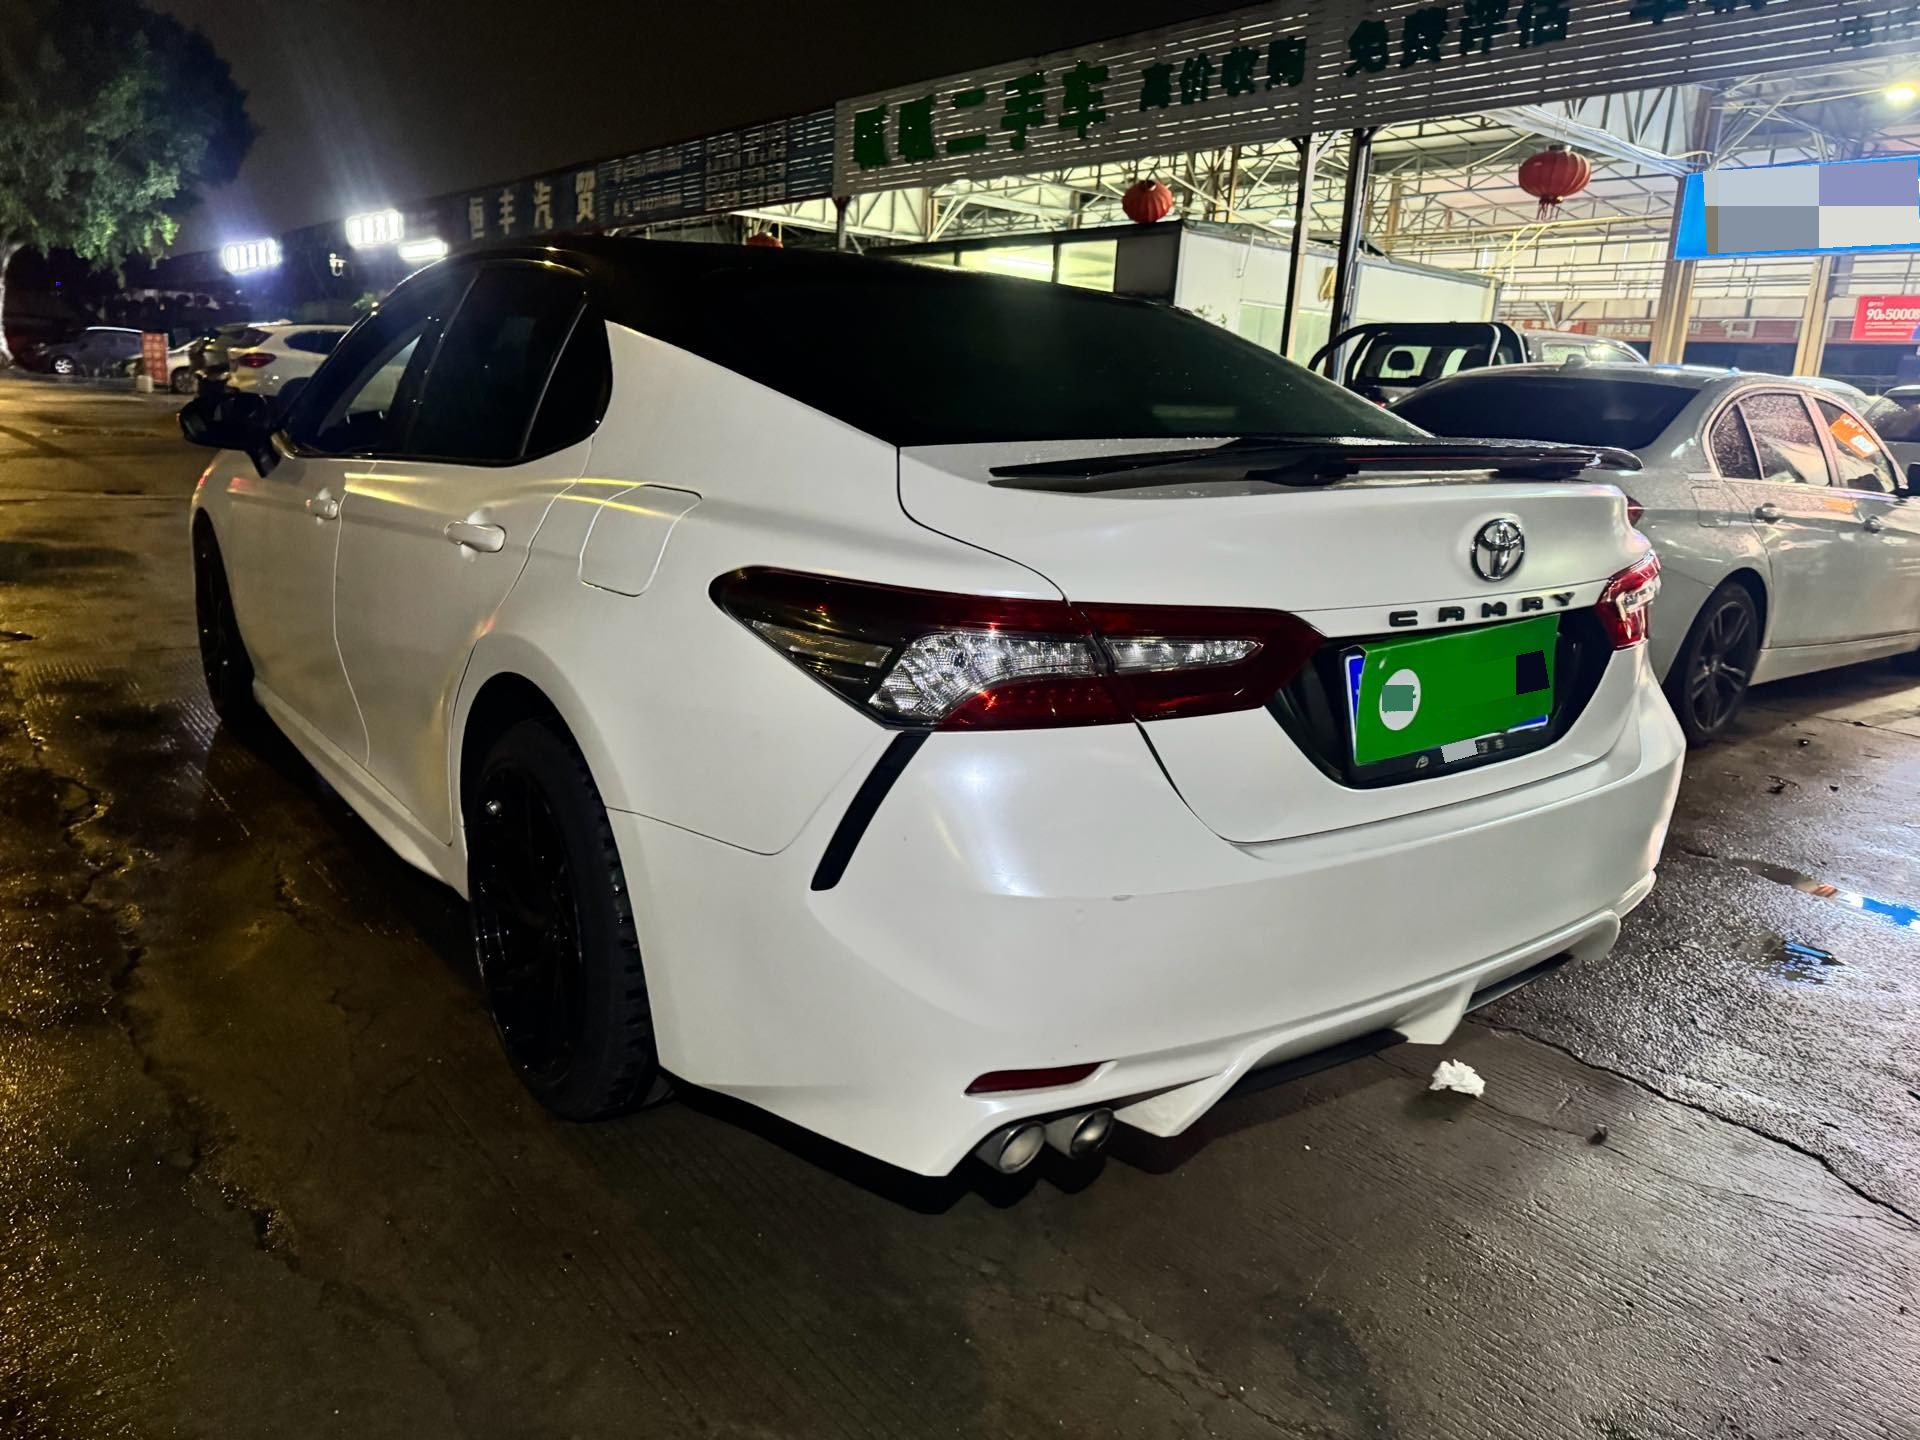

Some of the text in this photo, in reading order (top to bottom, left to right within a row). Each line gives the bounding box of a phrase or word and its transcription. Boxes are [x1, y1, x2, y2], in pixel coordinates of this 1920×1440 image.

[1139, 35, 1307, 112] 高价收购
[469, 169, 596, 240] 恒丰汽贸
[1389, 591, 1576, 627] CAMRY
